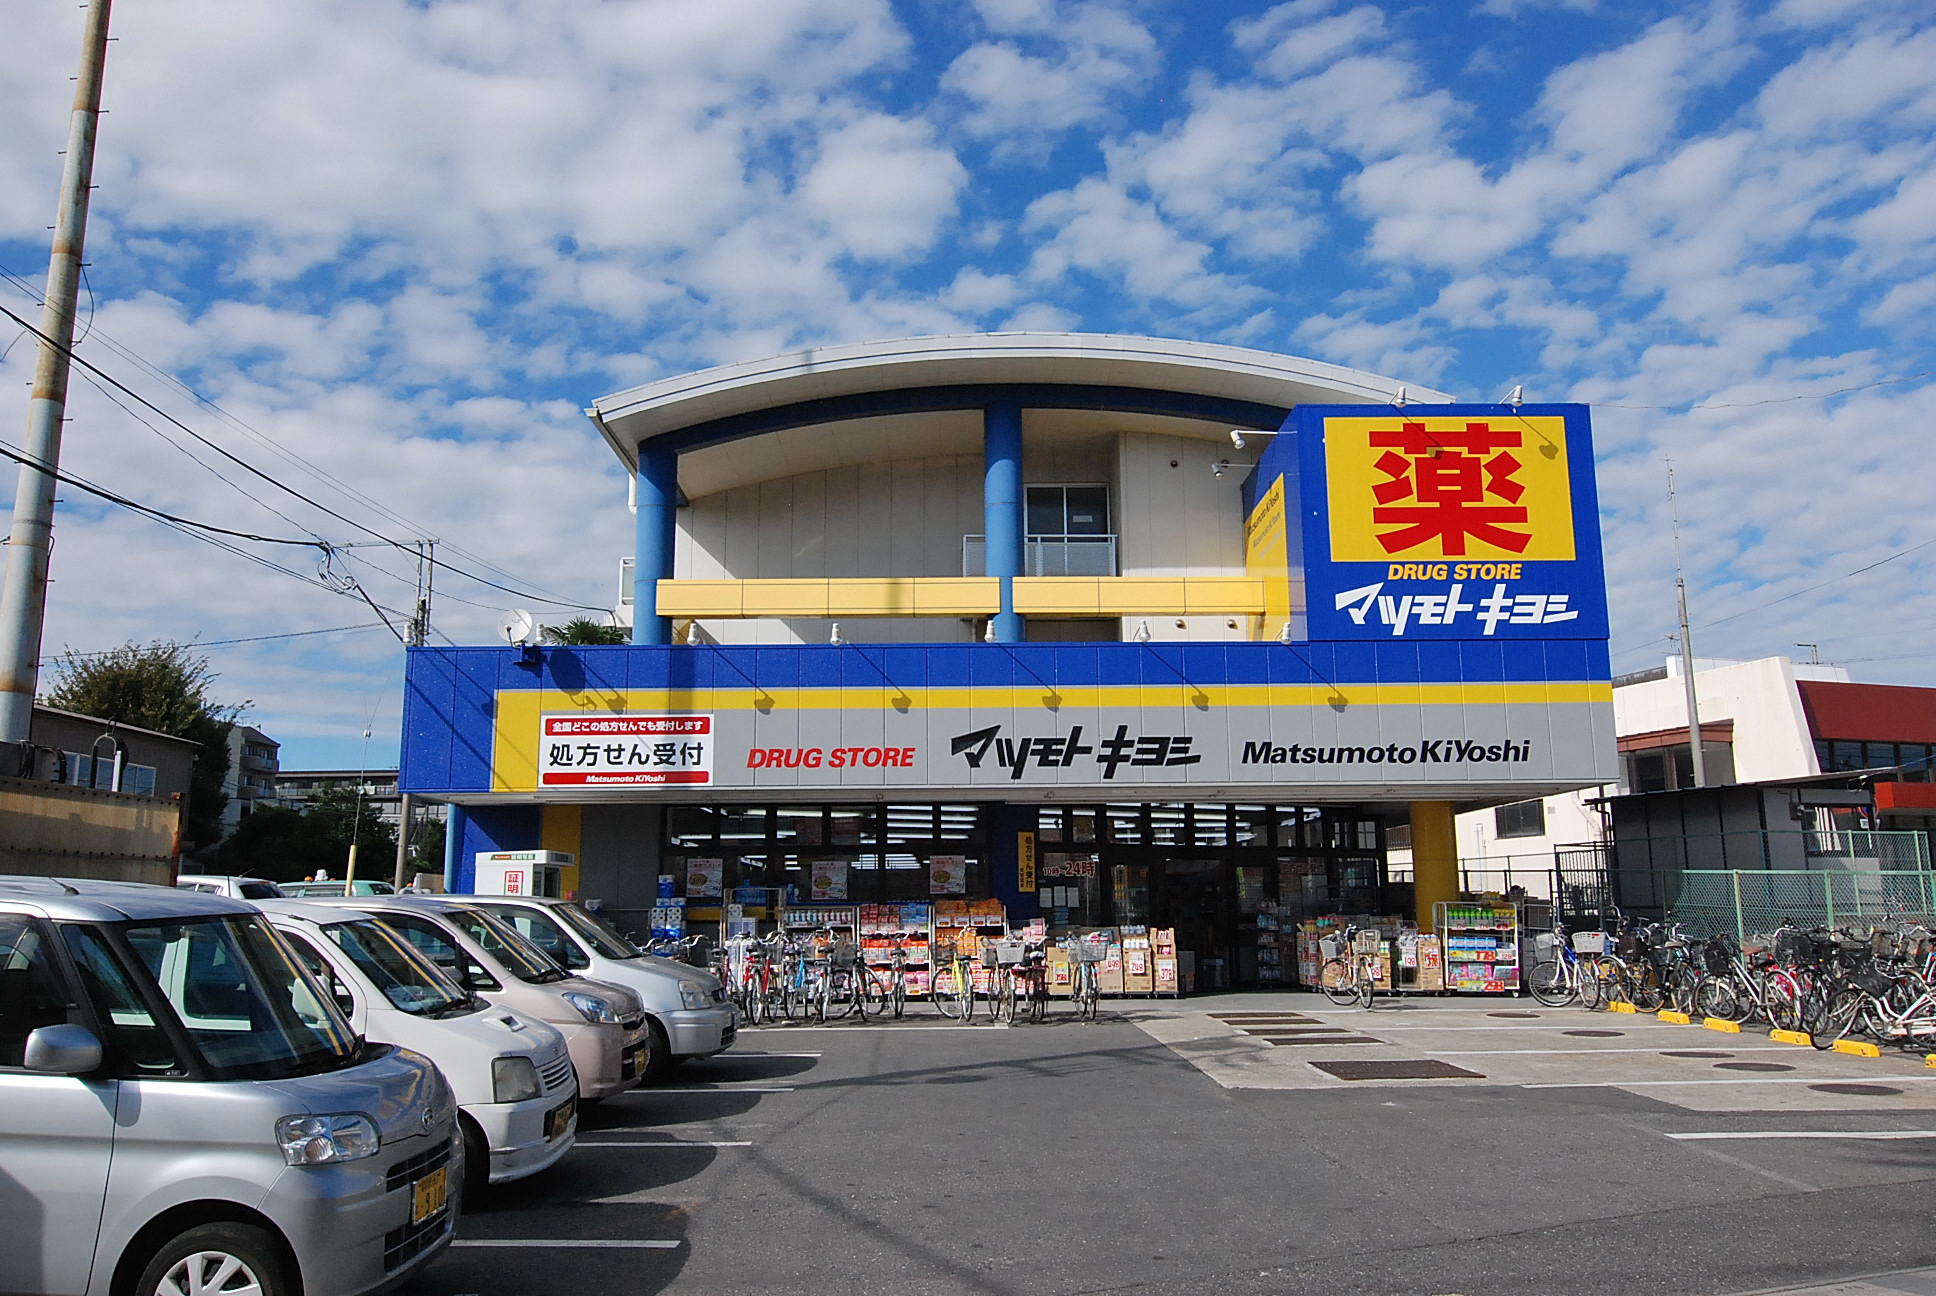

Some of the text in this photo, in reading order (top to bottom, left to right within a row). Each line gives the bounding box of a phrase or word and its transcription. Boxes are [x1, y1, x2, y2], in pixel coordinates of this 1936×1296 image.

[1369, 422, 1533, 556] 薬
[1388, 564, 1522, 580] DRUG STORE
[1335, 582, 1579, 636] マツモトキヨシ
[552, 720, 703, 732] 全国どこの処方せんでも受付します
[549, 742, 704, 767] 処方せん受付
[747, 747, 916, 769] DRUG STORE
[951, 724, 1201, 780] マツモトキヨシ
[1242, 740, 1531, 764] Matsumoto KiYoshi
[585, 774, 666, 783] Matsumoto KiYoshi
